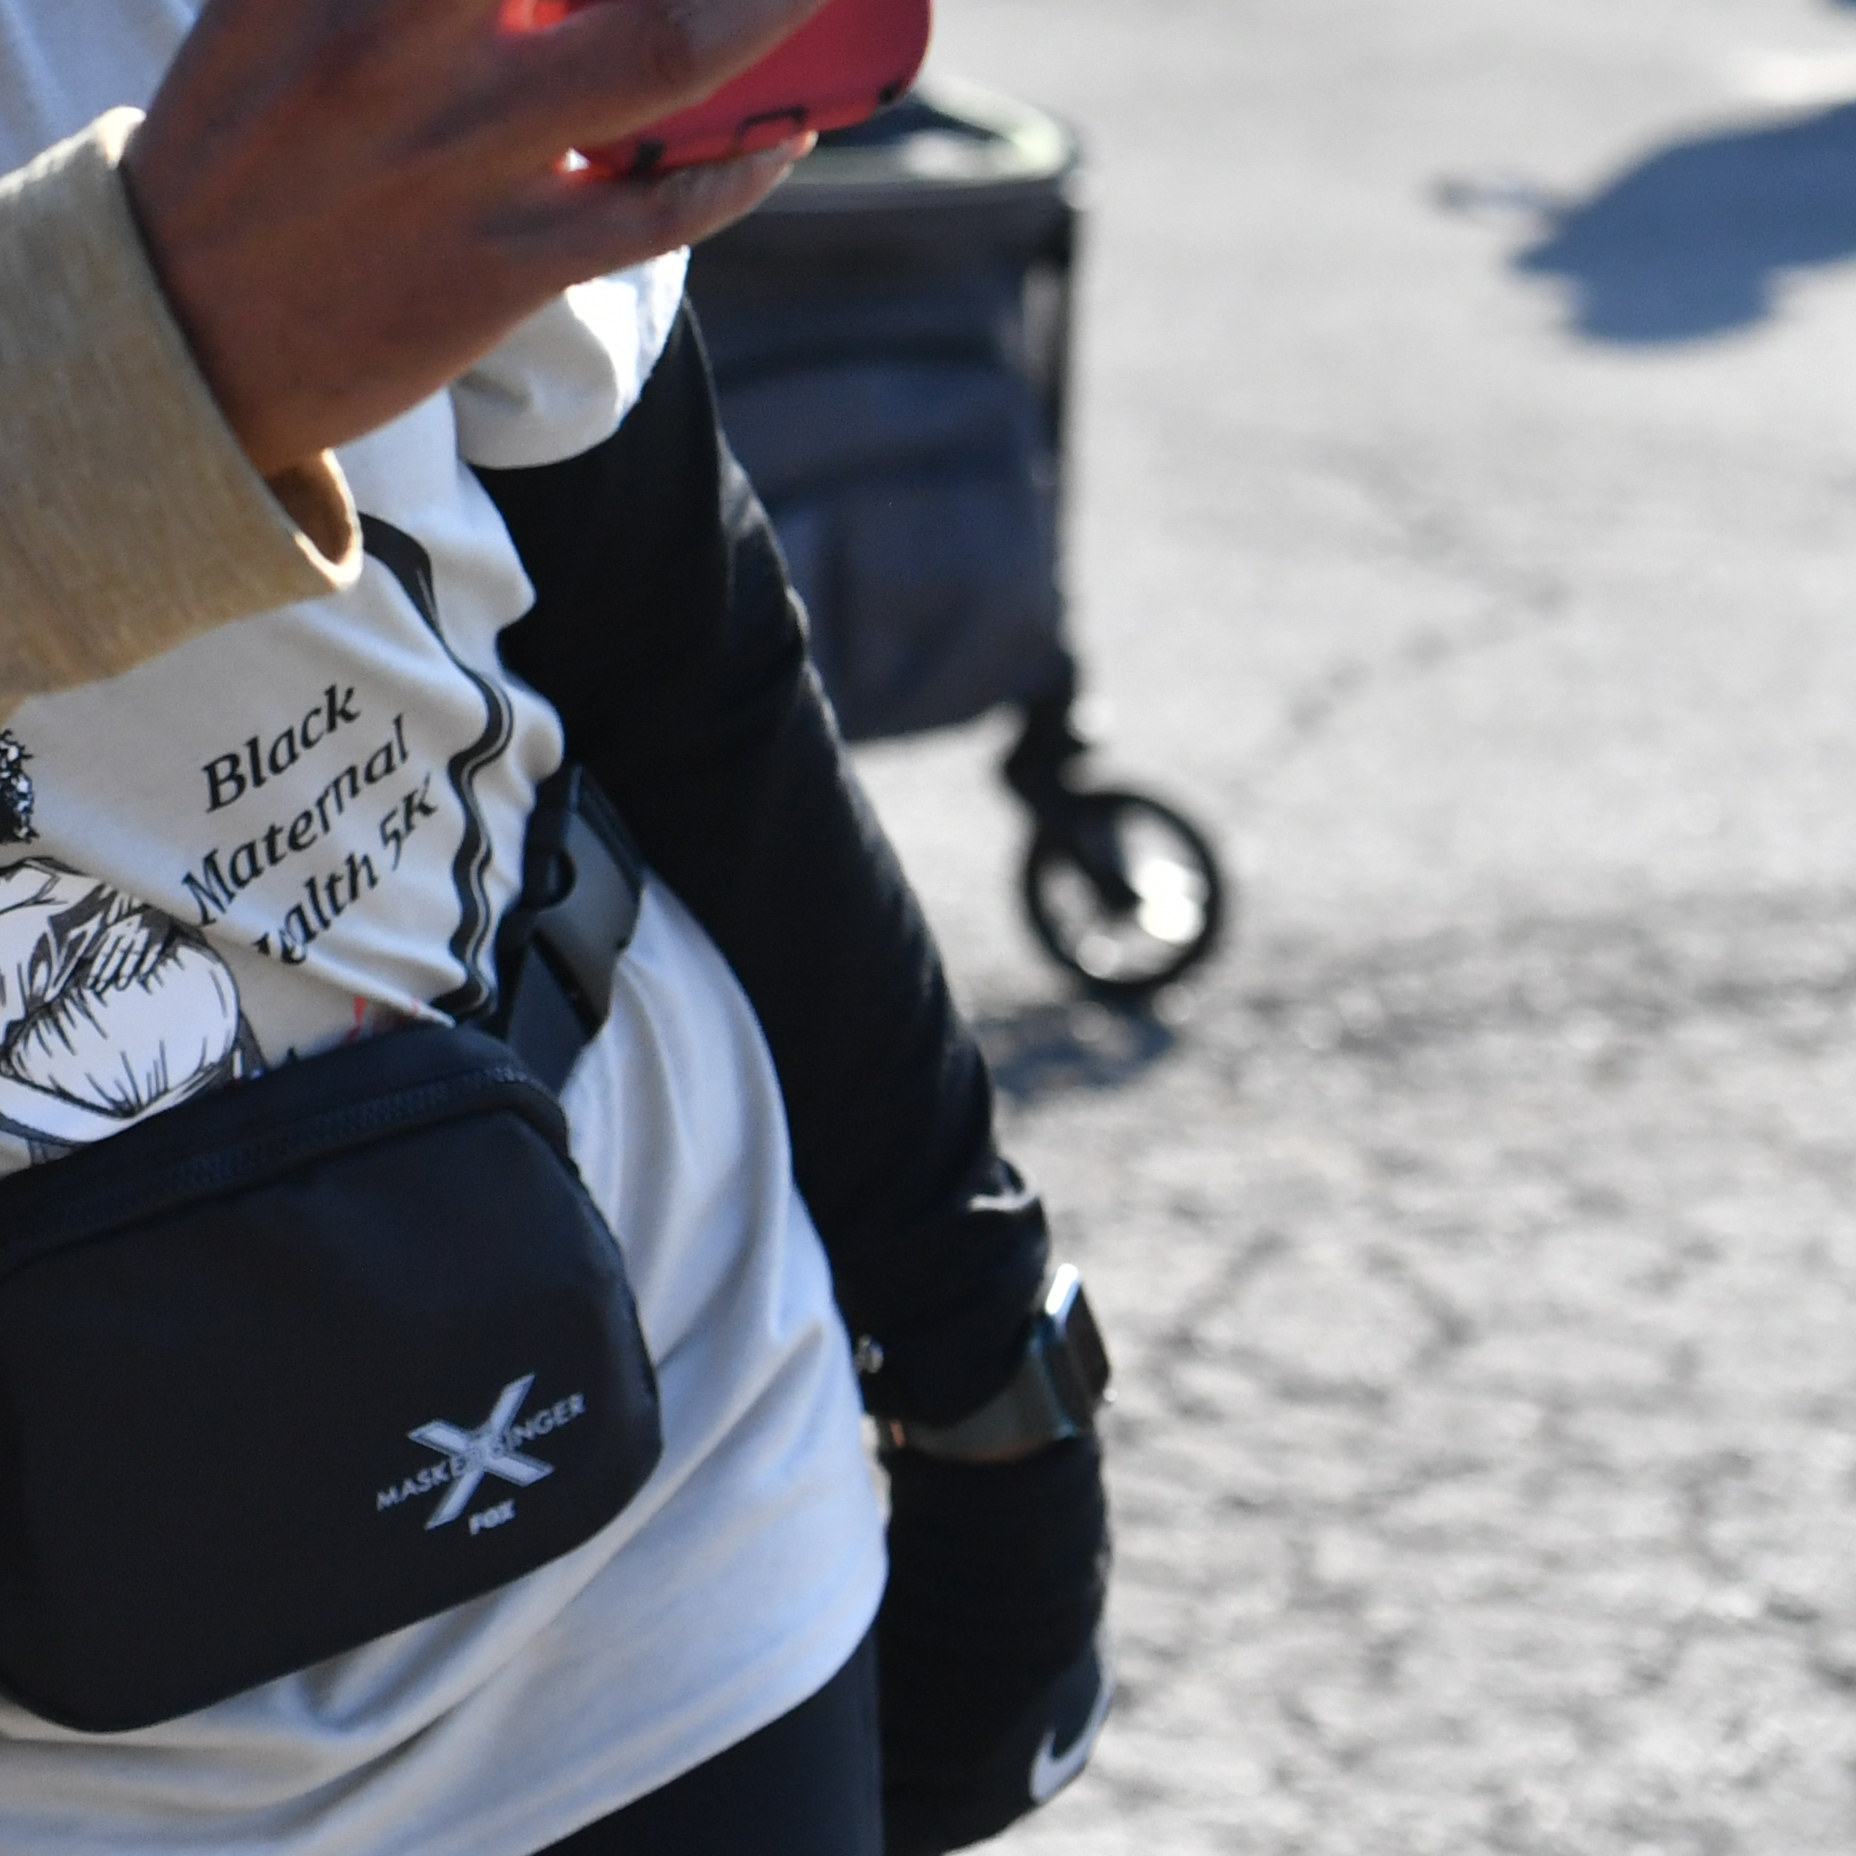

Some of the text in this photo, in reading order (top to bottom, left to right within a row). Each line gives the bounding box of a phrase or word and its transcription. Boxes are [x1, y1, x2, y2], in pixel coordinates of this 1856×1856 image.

[201, 683, 361, 814] Black
[181, 712, 410, 927] Maternal
[378, 771, 439, 872] 5K
